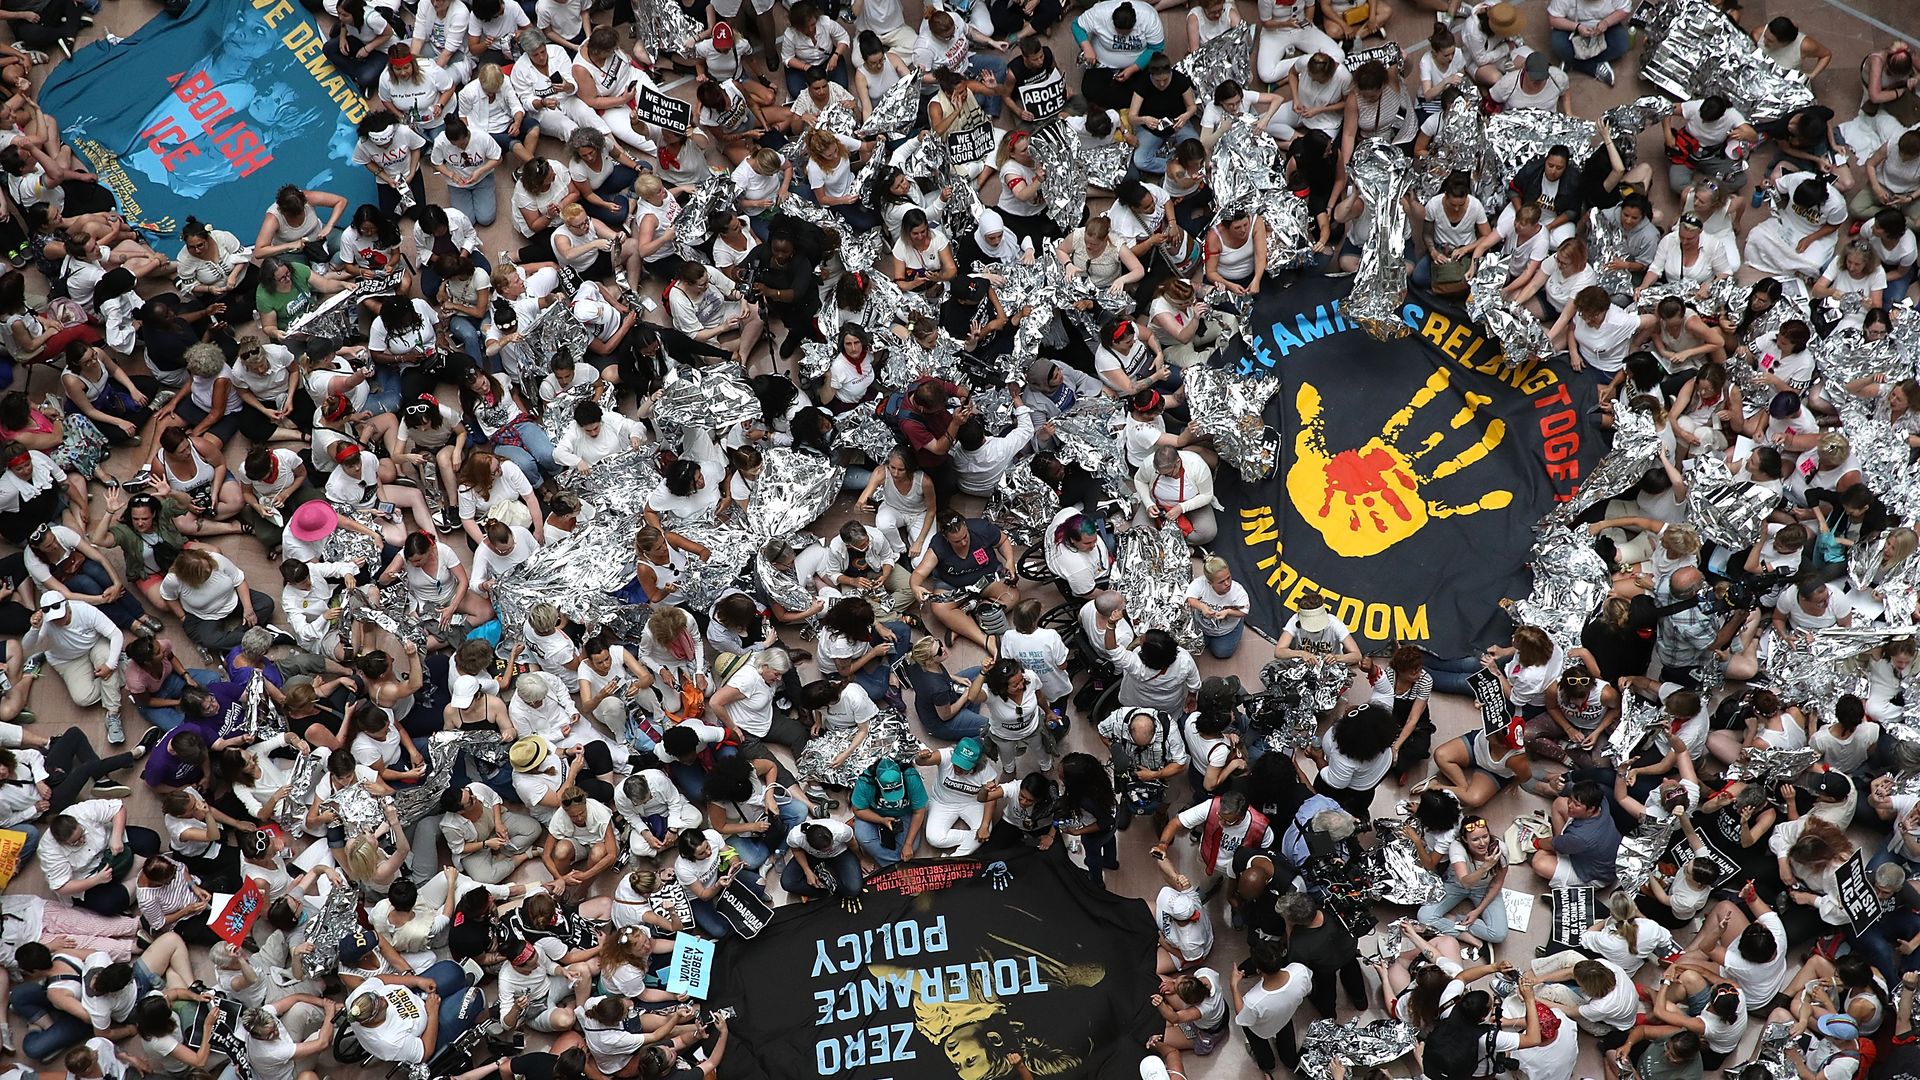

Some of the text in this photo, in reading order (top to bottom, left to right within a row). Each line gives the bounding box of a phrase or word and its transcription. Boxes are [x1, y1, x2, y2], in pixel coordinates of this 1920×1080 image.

[945, 36, 965, 59] WOMEN
[1344, 51, 1372, 65] WALLS
[282, 20, 370, 125] DEMAND
[645, 91, 684, 113] WE WILL
[652, 105, 673, 117] NOT
[637, 108, 686, 131] BE MOVED
[141, 115, 201, 172] ICE
[951, 139, 974, 153] TEAR
[956, 132, 970, 145] WE
[951, 151, 975, 165] YOUR
[1240, 506, 1279, 546] IN
[1491, 679, 1500, 693] NO
[1478, 681, 1498, 725] CALLADOS
[945, 778, 963, 790] DEPORT
[0, 839, 12, 869] REEDOM
[3, 842, 22, 877] FOR ALL
[1717, 857, 1735, 875] UNTIL
[876, 870, 974, 892] #ENDFAMILYDETENTION
[900, 880, 953, 896] #ABOLISHICE
[1850, 858, 1878, 918] ABOLISH
[672, 880, 692, 923] WOMEN
[723, 890, 763, 930] SOLIDARIDAD
[1578, 888, 1587, 920] HUMANITY
[1841, 877, 1863, 921] I.C.E.
[1560, 887, 1571, 945] FAMILY SEPARATION
[1570, 901, 1578, 936] IS A CRIME
[811, 915, 948, 978] POLICY
[679, 946, 695, 982] WOMEN
[689, 947, 704, 988] DISOBEY
[386, 991, 411, 1021] WOMEN
[394, 988, 420, 1019] DISOBEY
[814, 956, 1049, 1026] TOLERANCE
[457, 999, 470, 1020] DEPORT
[226, 1032, 240, 1048] WE
[815, 1021, 917, 1076] ZERO
[213, 1032, 232, 1048] THE
[231, 1046, 252, 1080] PEOPL
